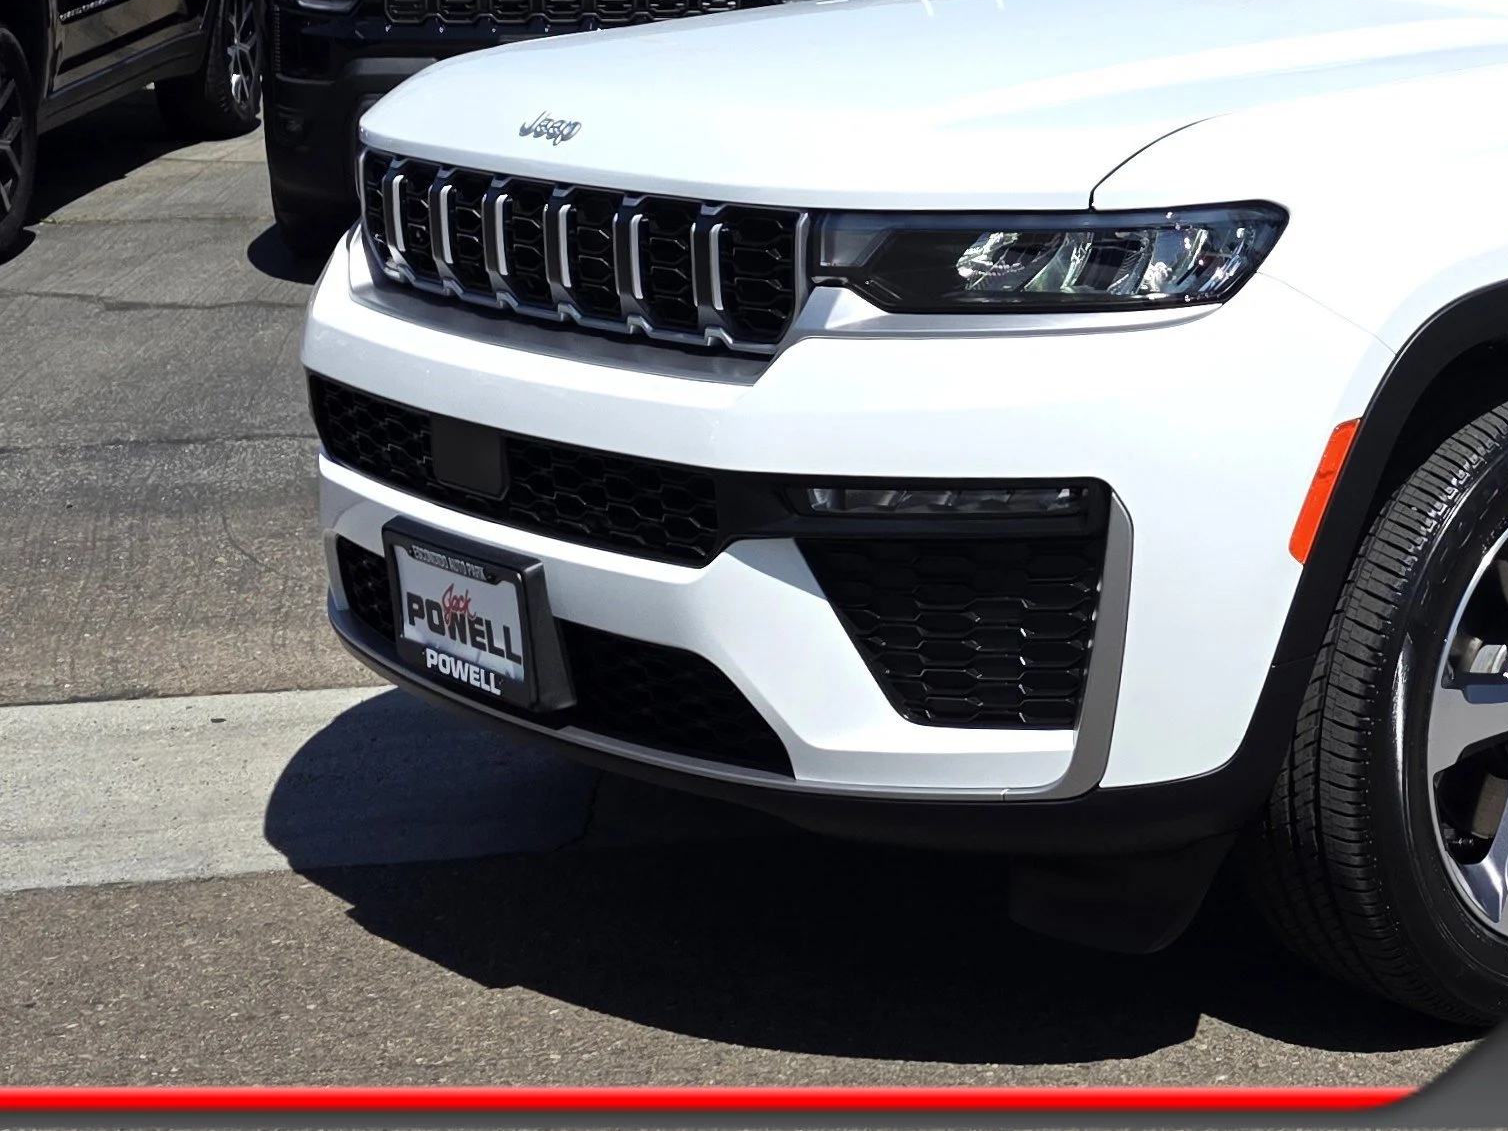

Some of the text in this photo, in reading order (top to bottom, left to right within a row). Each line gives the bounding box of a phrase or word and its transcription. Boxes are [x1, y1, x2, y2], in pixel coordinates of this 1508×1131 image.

[518, 110, 582, 147] Jeep
[441, 583, 477, 625] Jack
[406, 591, 522, 665] POWELL
[425, 647, 502, 696] POWELL
